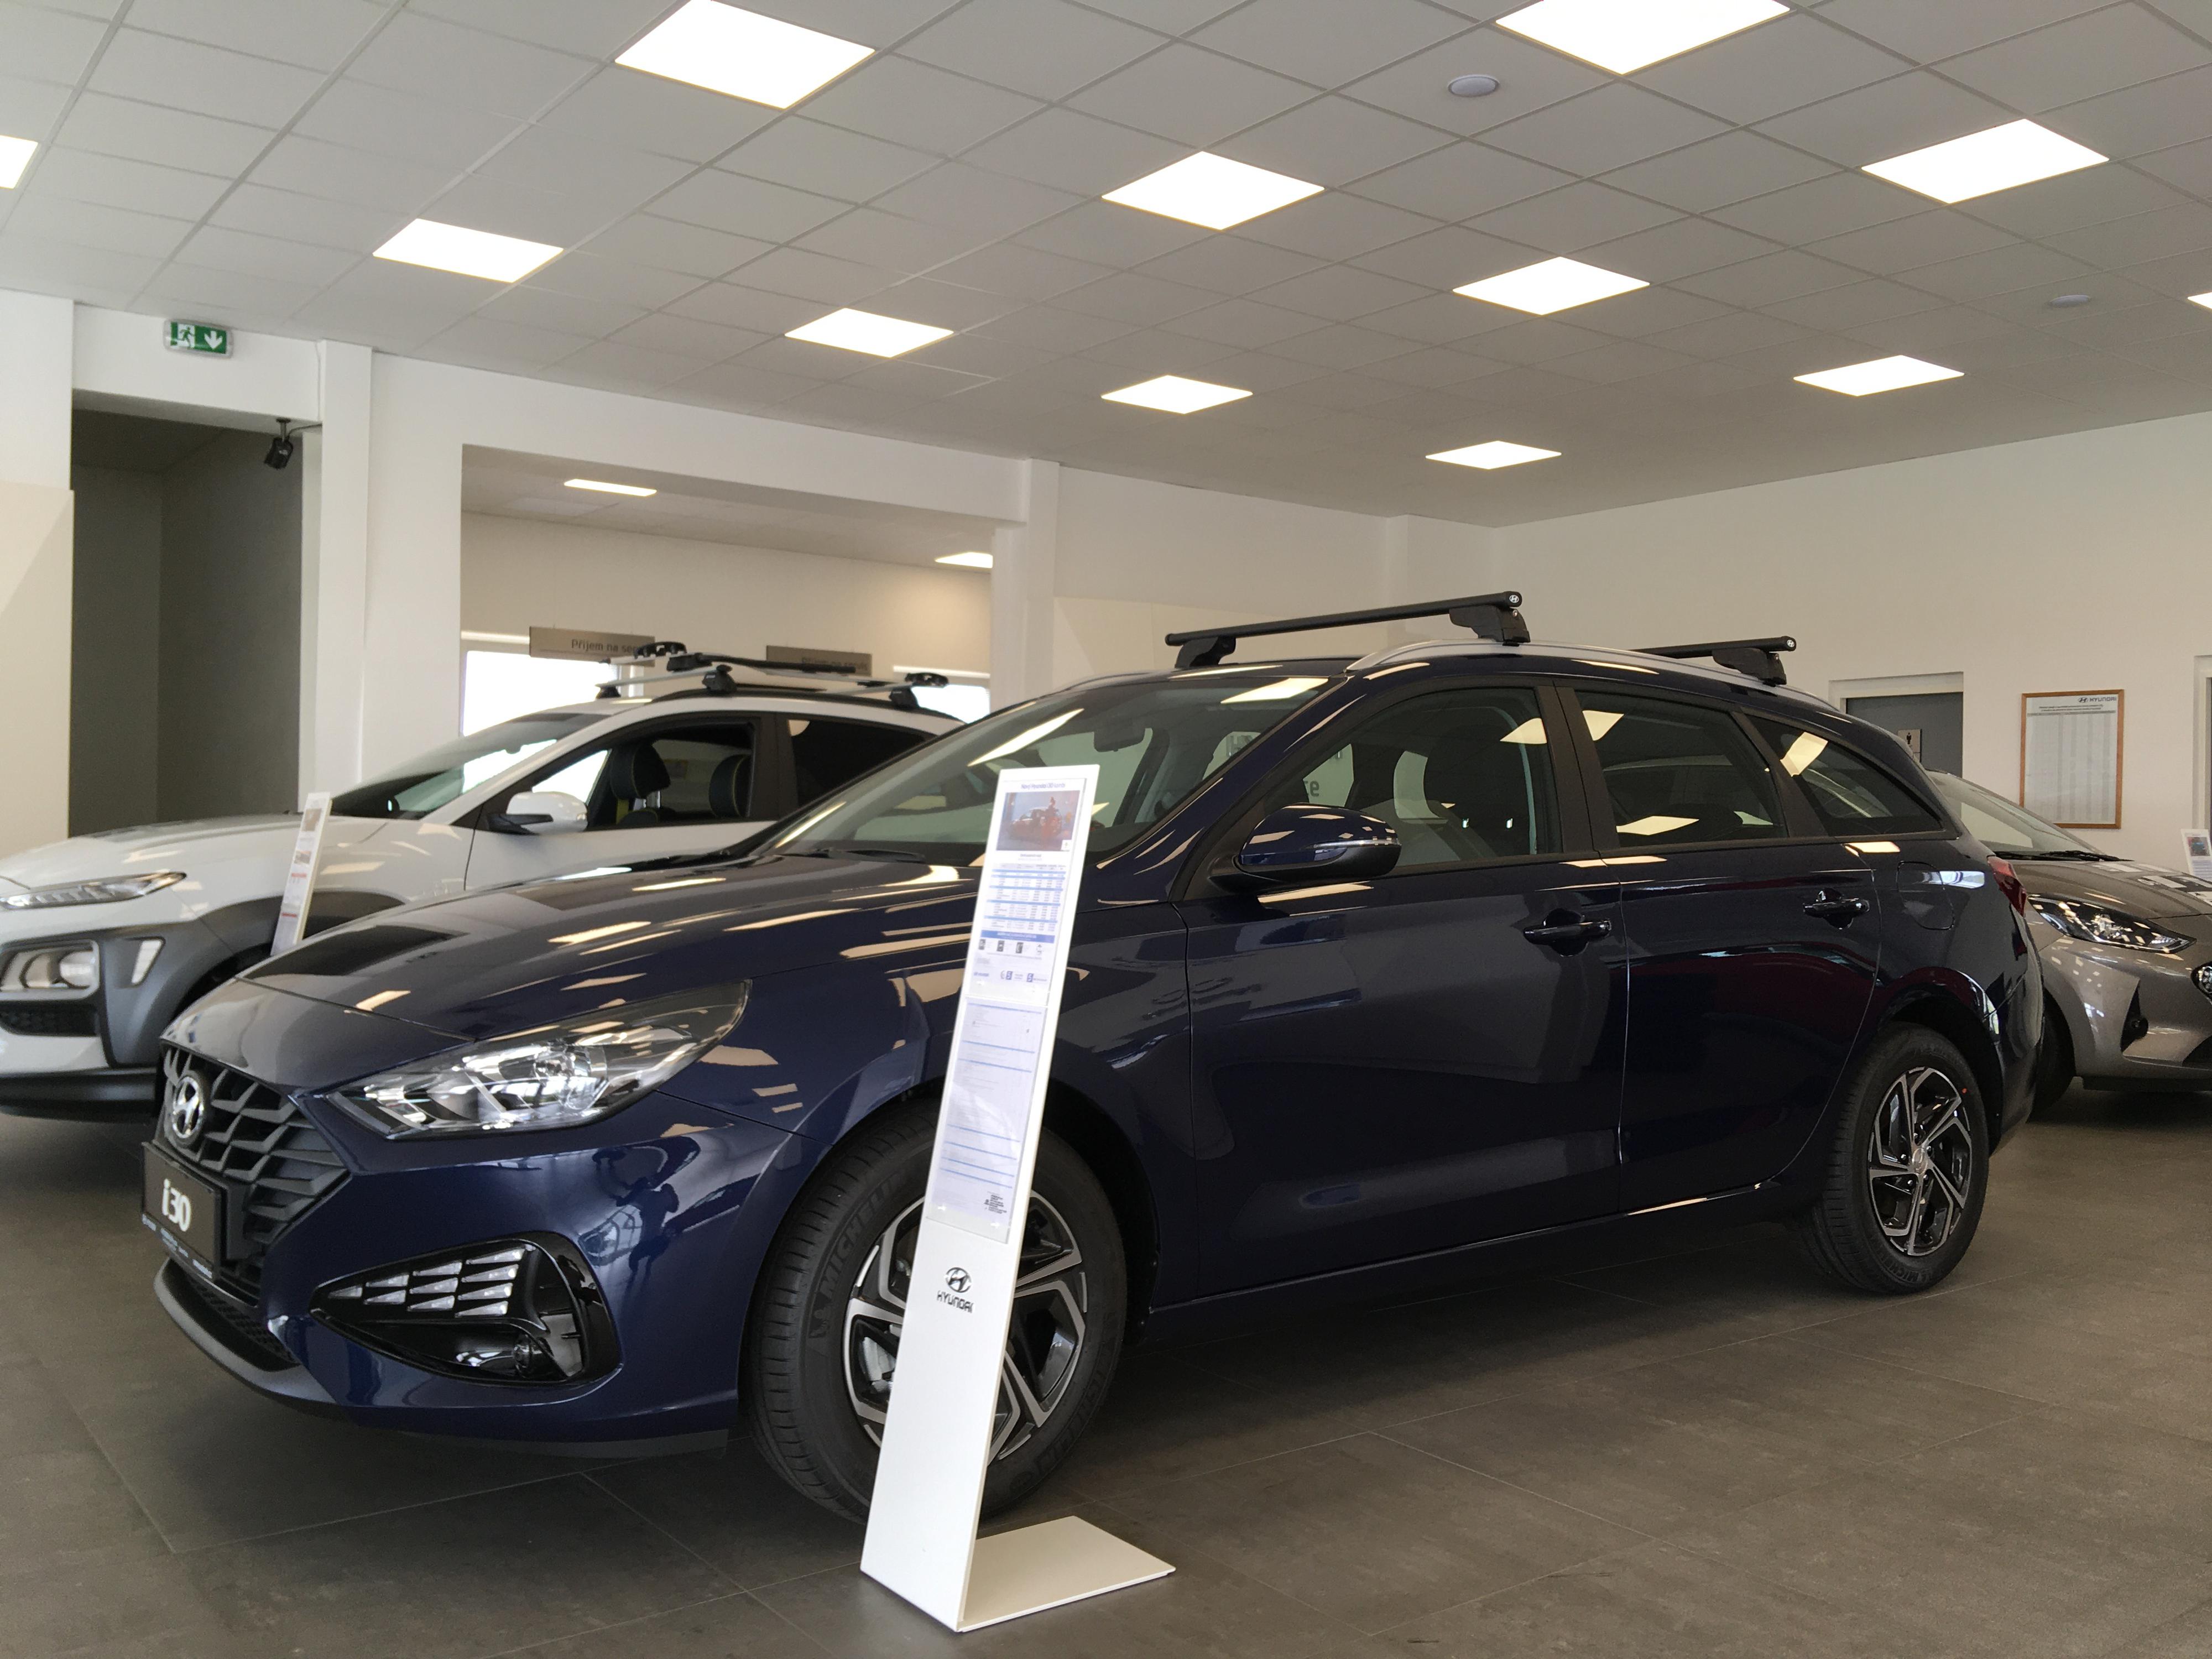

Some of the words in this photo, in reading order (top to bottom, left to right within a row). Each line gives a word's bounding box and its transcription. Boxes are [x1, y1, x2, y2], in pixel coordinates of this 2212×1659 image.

[606, 644, 619, 652] na
[161, 1177, 192, 1232] i30
[936, 1290, 974, 1314] HYUNDAI
